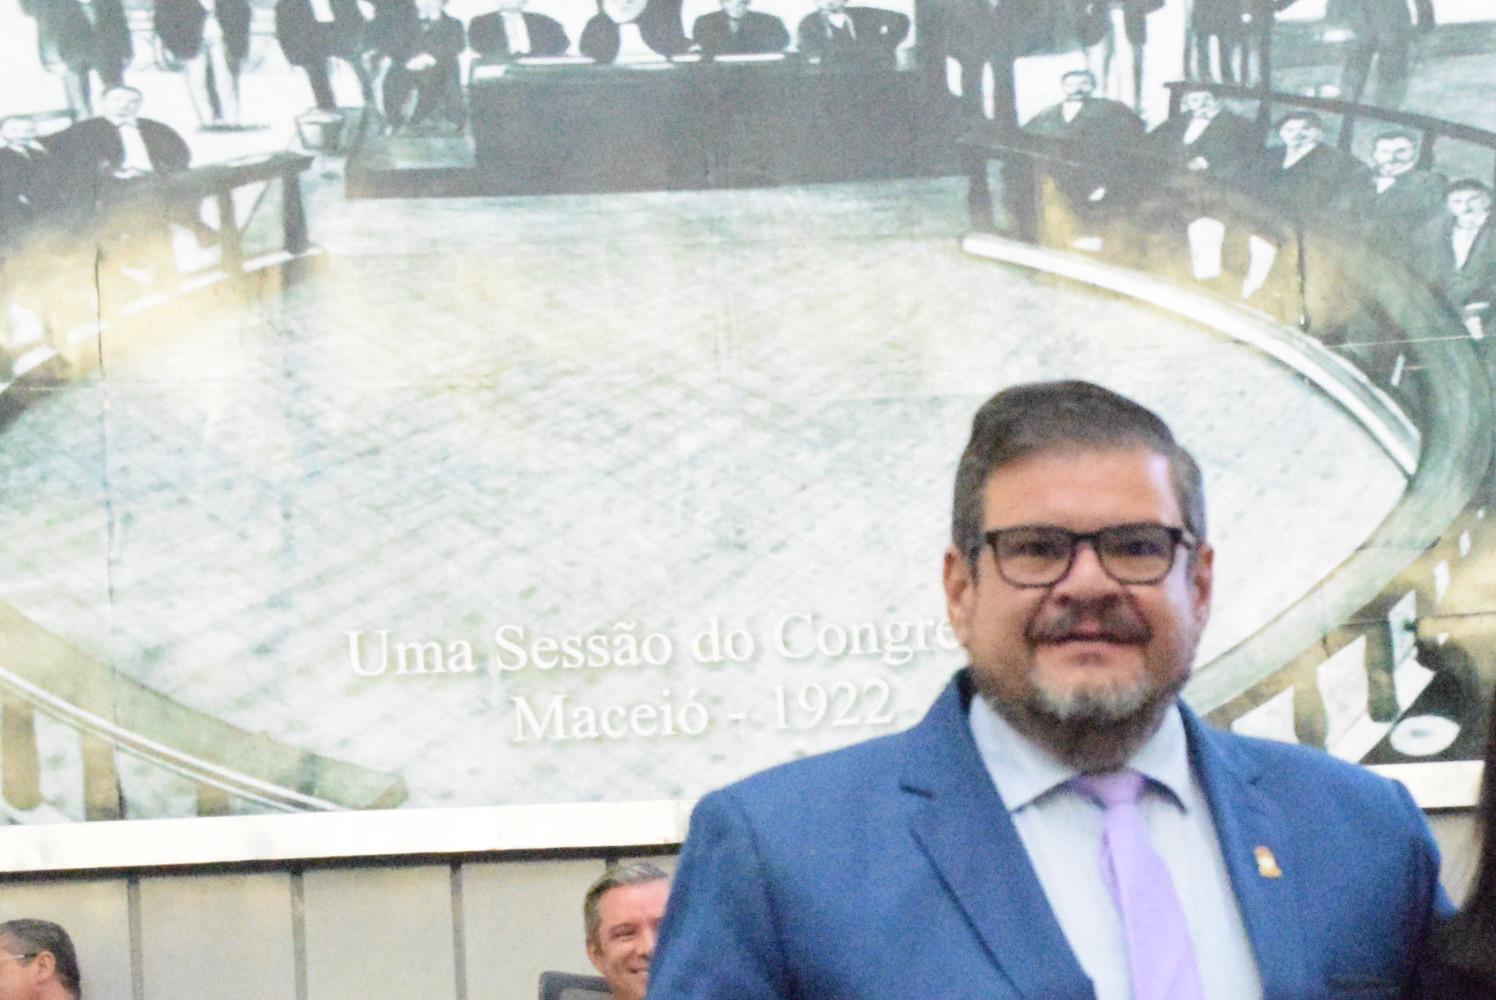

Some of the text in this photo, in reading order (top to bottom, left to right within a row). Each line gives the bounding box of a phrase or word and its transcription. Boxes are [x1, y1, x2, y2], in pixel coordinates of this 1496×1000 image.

[344, 629, 479, 677] Uma
[494, 620, 673, 672] Sessão
[691, 616, 755, 663] do
[510, 687, 709, 742] Maceió
[771, 678, 894, 730] 1922
